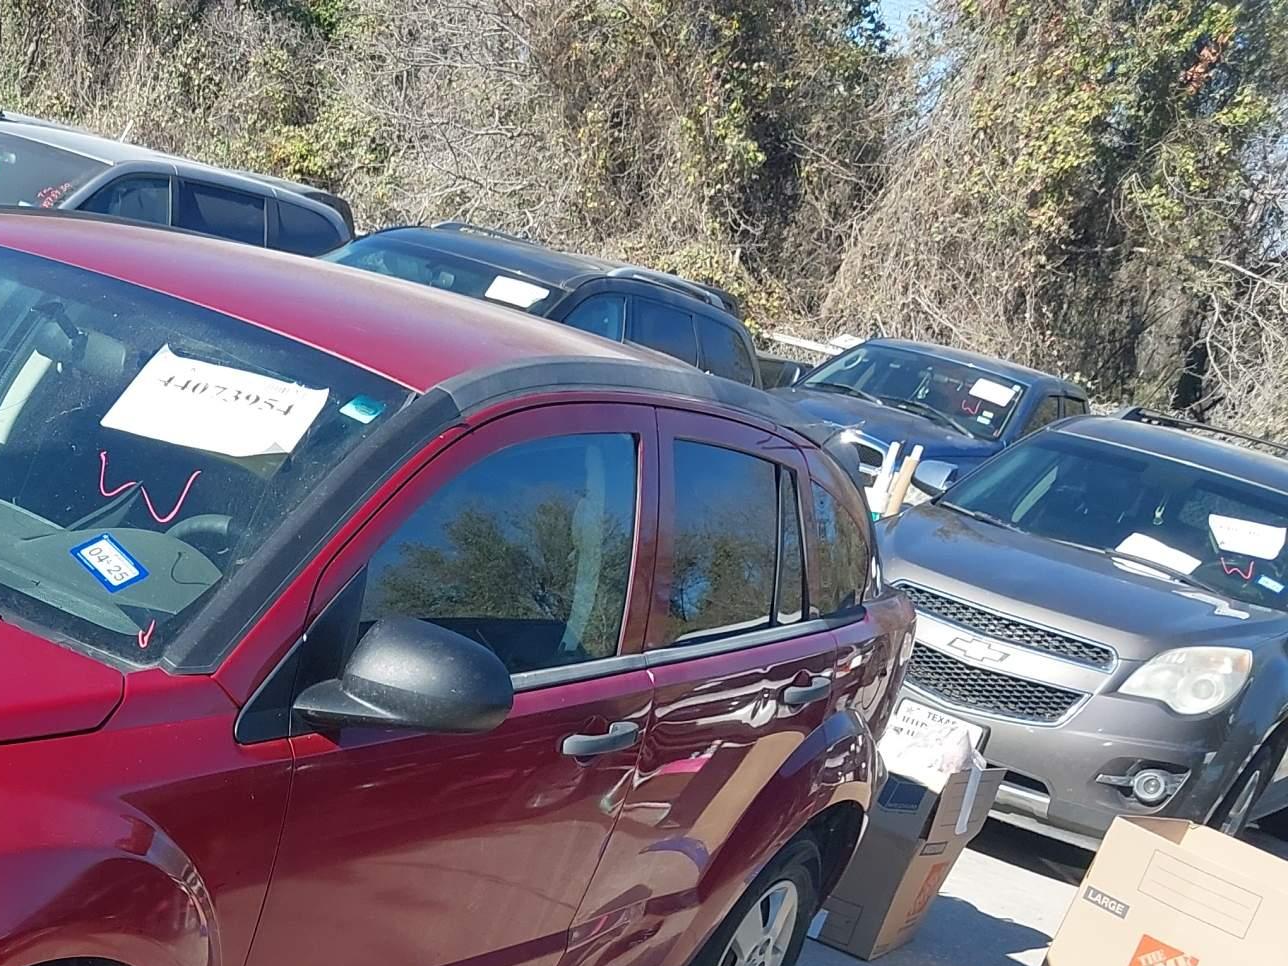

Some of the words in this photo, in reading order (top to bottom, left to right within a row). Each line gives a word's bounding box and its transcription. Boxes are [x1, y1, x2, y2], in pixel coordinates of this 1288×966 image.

[158, 374, 296, 416] 44073954
[1088, 888, 1125, 915] LARGE
[1138, 949, 1167, 966] THE
